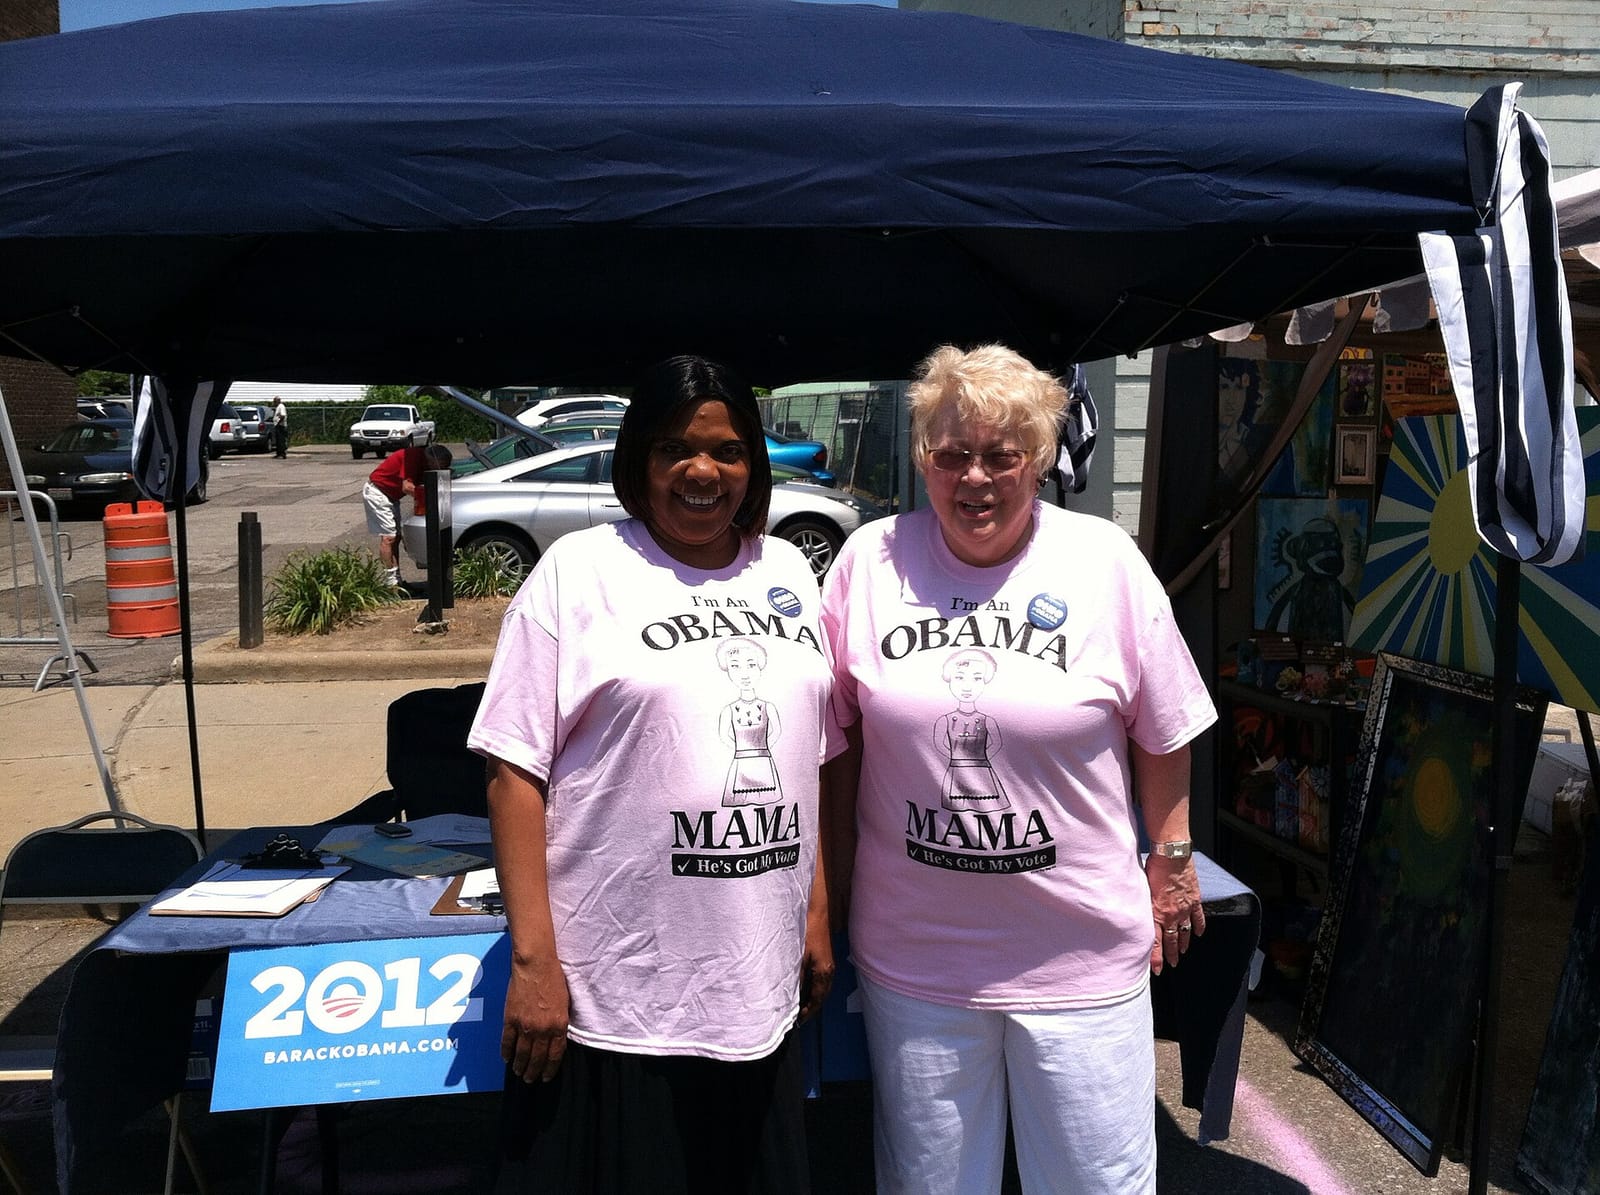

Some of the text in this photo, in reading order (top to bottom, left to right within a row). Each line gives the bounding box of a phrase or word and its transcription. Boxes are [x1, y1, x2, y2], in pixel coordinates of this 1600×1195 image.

[691, 595, 750, 608] I'm An
[950, 597, 1011, 612] I'm An
[641, 610, 825, 657] OBAMA
[880, 615, 1068, 674] OBAMA
[669, 802, 801, 849] MAMA
[905, 800, 1055, 851] MAMA
[697, 859, 732, 874] He's
[735, 857, 758, 874] Got
[760, 855, 774, 869] My
[775, 850, 797, 864] Vote
[923, 851, 1048, 873] He's Got My Vote
[245, 953, 484, 1040] 2012
[263, 1037, 459, 1065] BARACKOBAMA.COM
